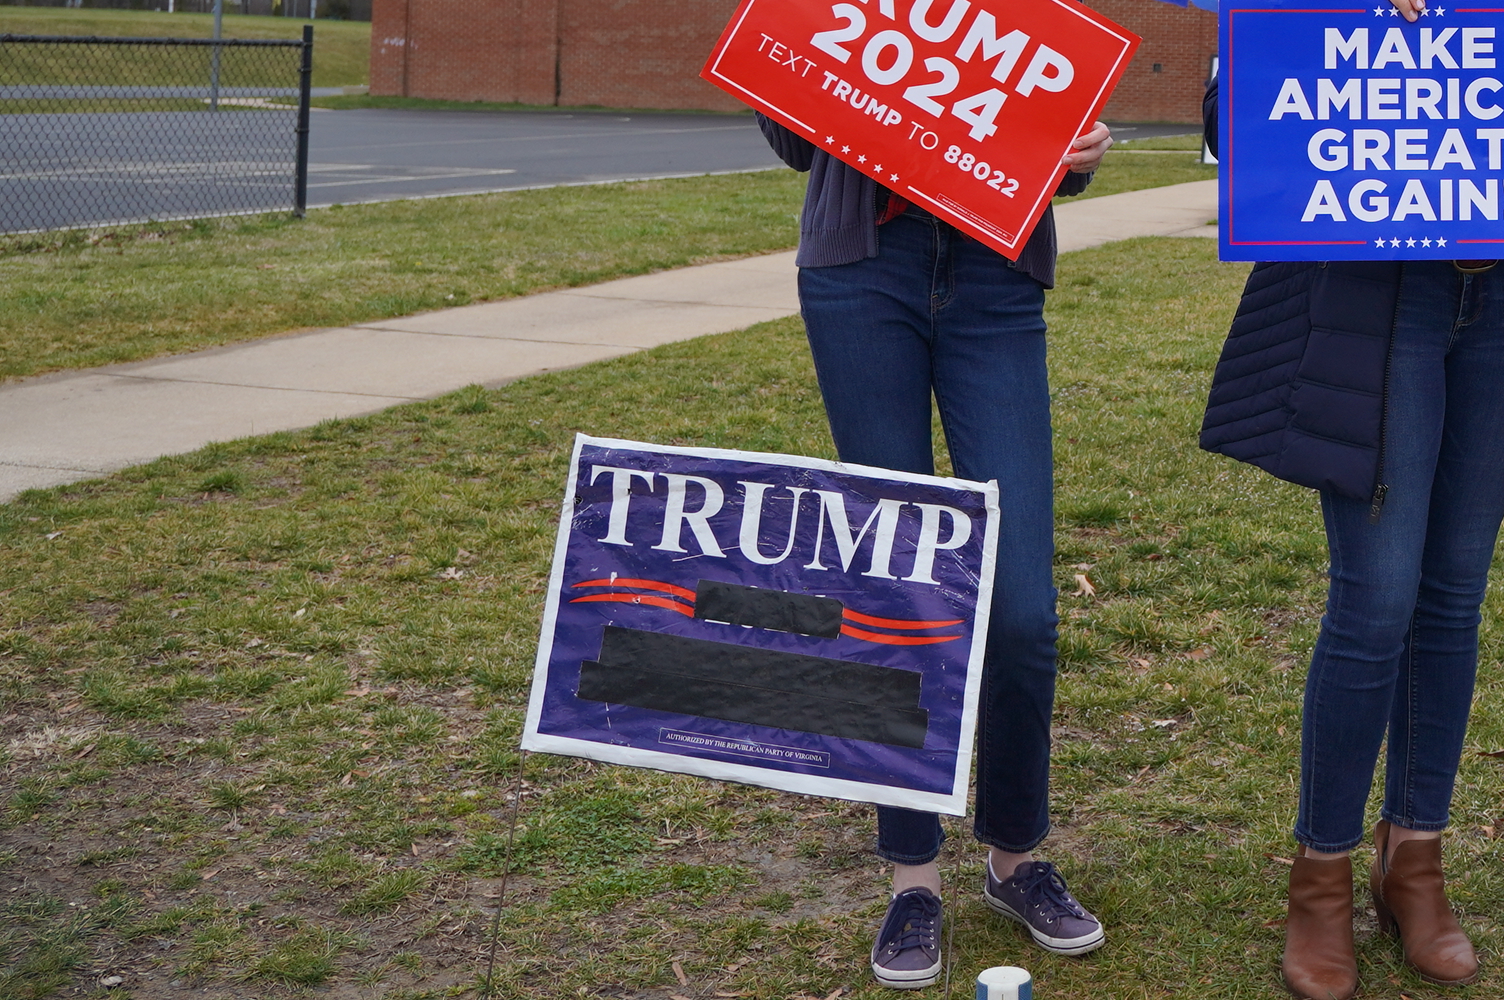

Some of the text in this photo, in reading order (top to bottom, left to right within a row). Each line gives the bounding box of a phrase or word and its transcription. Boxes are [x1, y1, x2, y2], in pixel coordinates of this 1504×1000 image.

[809, 3, 1008, 143] 2024
[1324, 27, 1496, 70] MAKE
[757, 32, 1021, 199] TEXT TRUMP TO 88022
[589, 464, 973, 585] TRUMP
[666, 732, 823, 763] AUTHORIZED BY THE REPUBLICAN PARTY OF VIRGINIA
